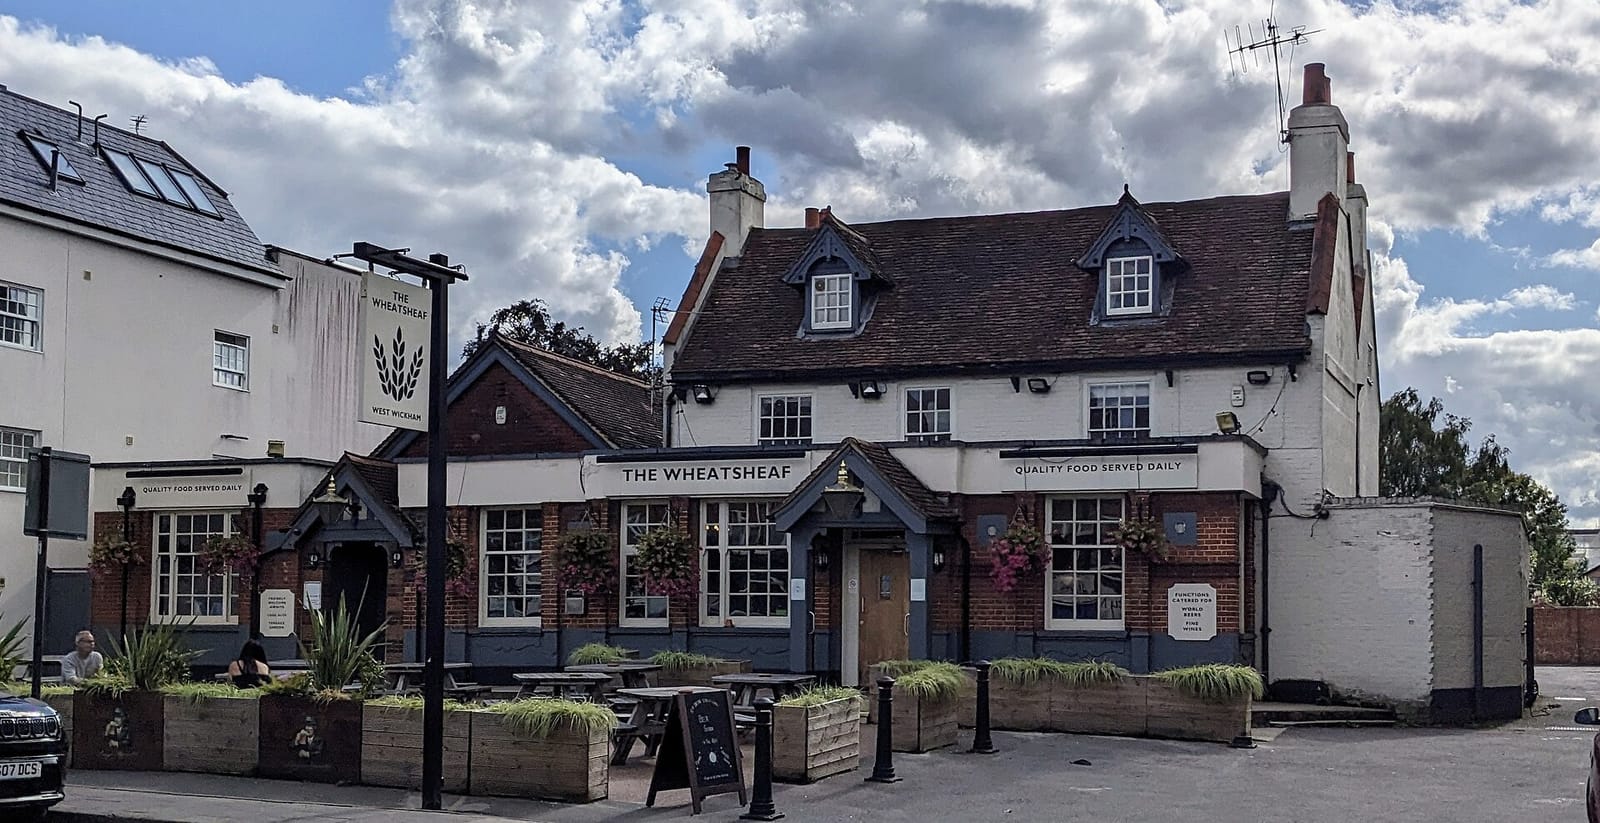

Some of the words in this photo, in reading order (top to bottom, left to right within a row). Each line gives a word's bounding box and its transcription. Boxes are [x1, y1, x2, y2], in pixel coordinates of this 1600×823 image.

[393, 291, 409, 304] THE
[372, 297, 428, 320] WHEATSHEAF
[372, 406, 390, 417] WEST
[391, 410, 422, 422] WICKHAM
[622, 469, 657, 482] THE
[663, 465, 791, 481] WHEATSHEAF
[1015, 465, 1064, 475] QUALITY
[1067, 464, 1098, 473] FOOD
[1102, 463, 1144, 472] SERVED
[1148, 462, 1182, 471] DAILY
[143, 486, 172, 494] QUALITY
[18, 763, 37, 776] DCS
